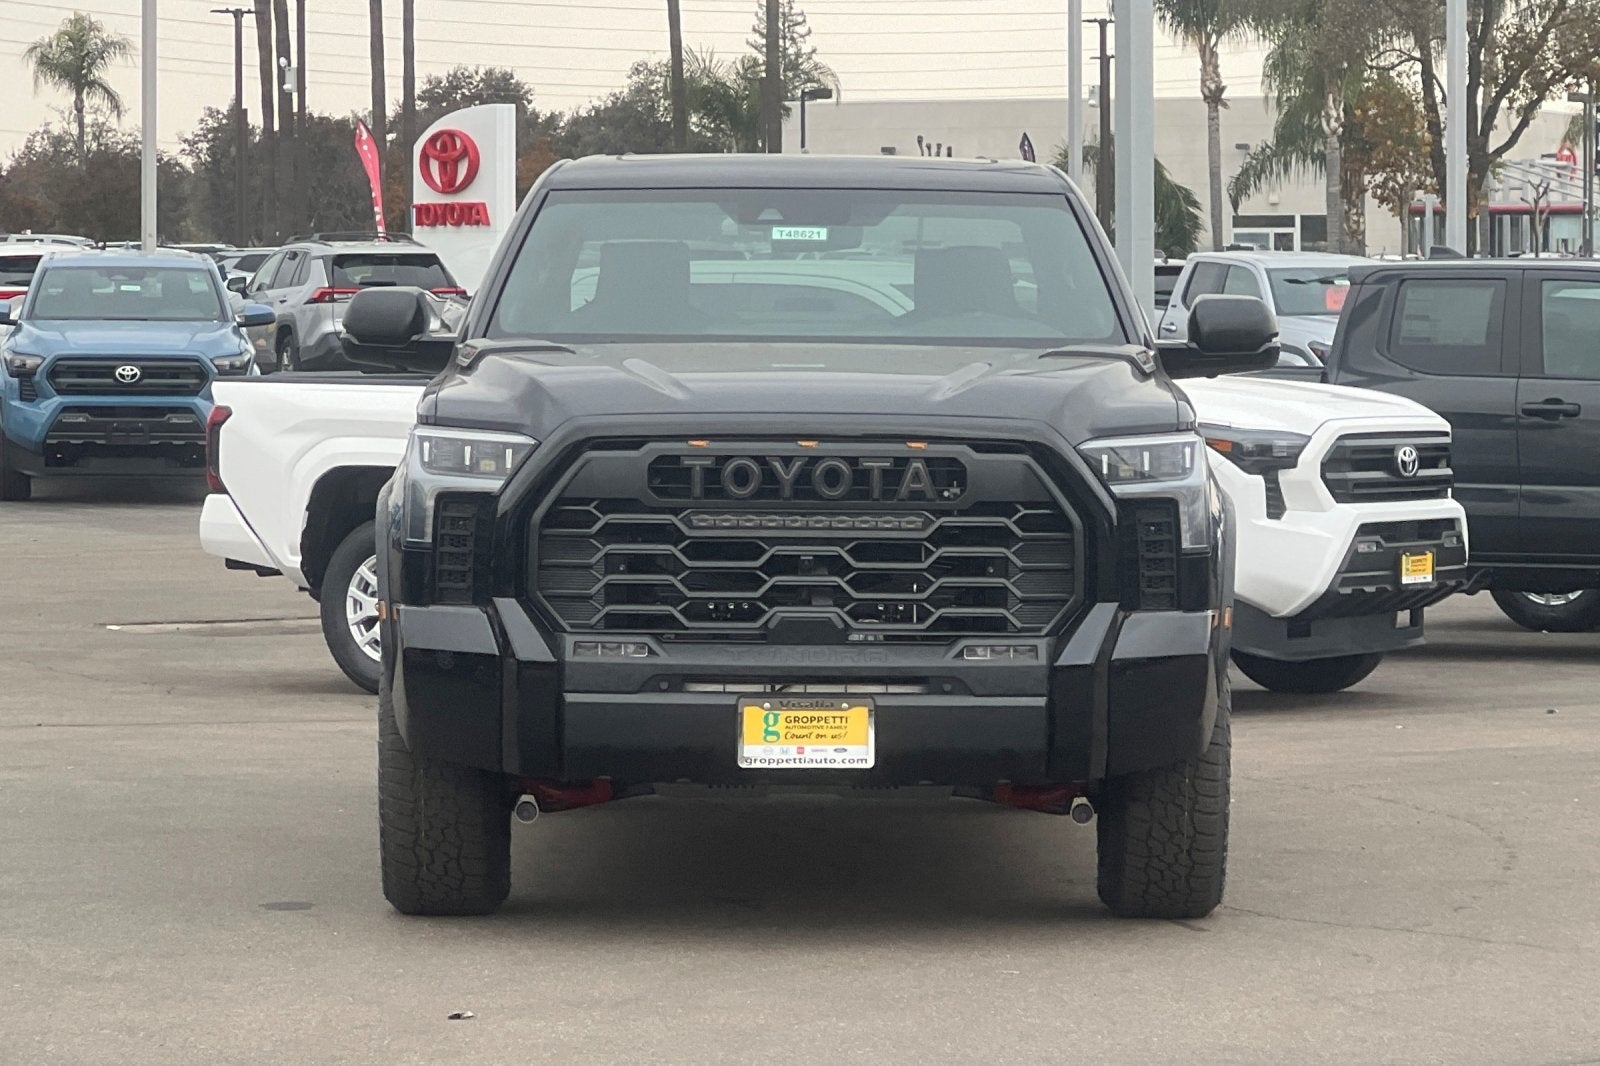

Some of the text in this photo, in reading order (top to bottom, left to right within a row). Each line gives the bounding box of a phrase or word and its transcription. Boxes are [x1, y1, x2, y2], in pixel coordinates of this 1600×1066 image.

[412, 202, 491, 227] TOYOTA
[777, 229, 821, 239] T48621
[679, 455, 938, 500] TOYOTA
[784, 715, 848, 724] GROPPETTI
[784, 731, 813, 740] Count
[744, 757, 868, 766] groppettiauto.com
